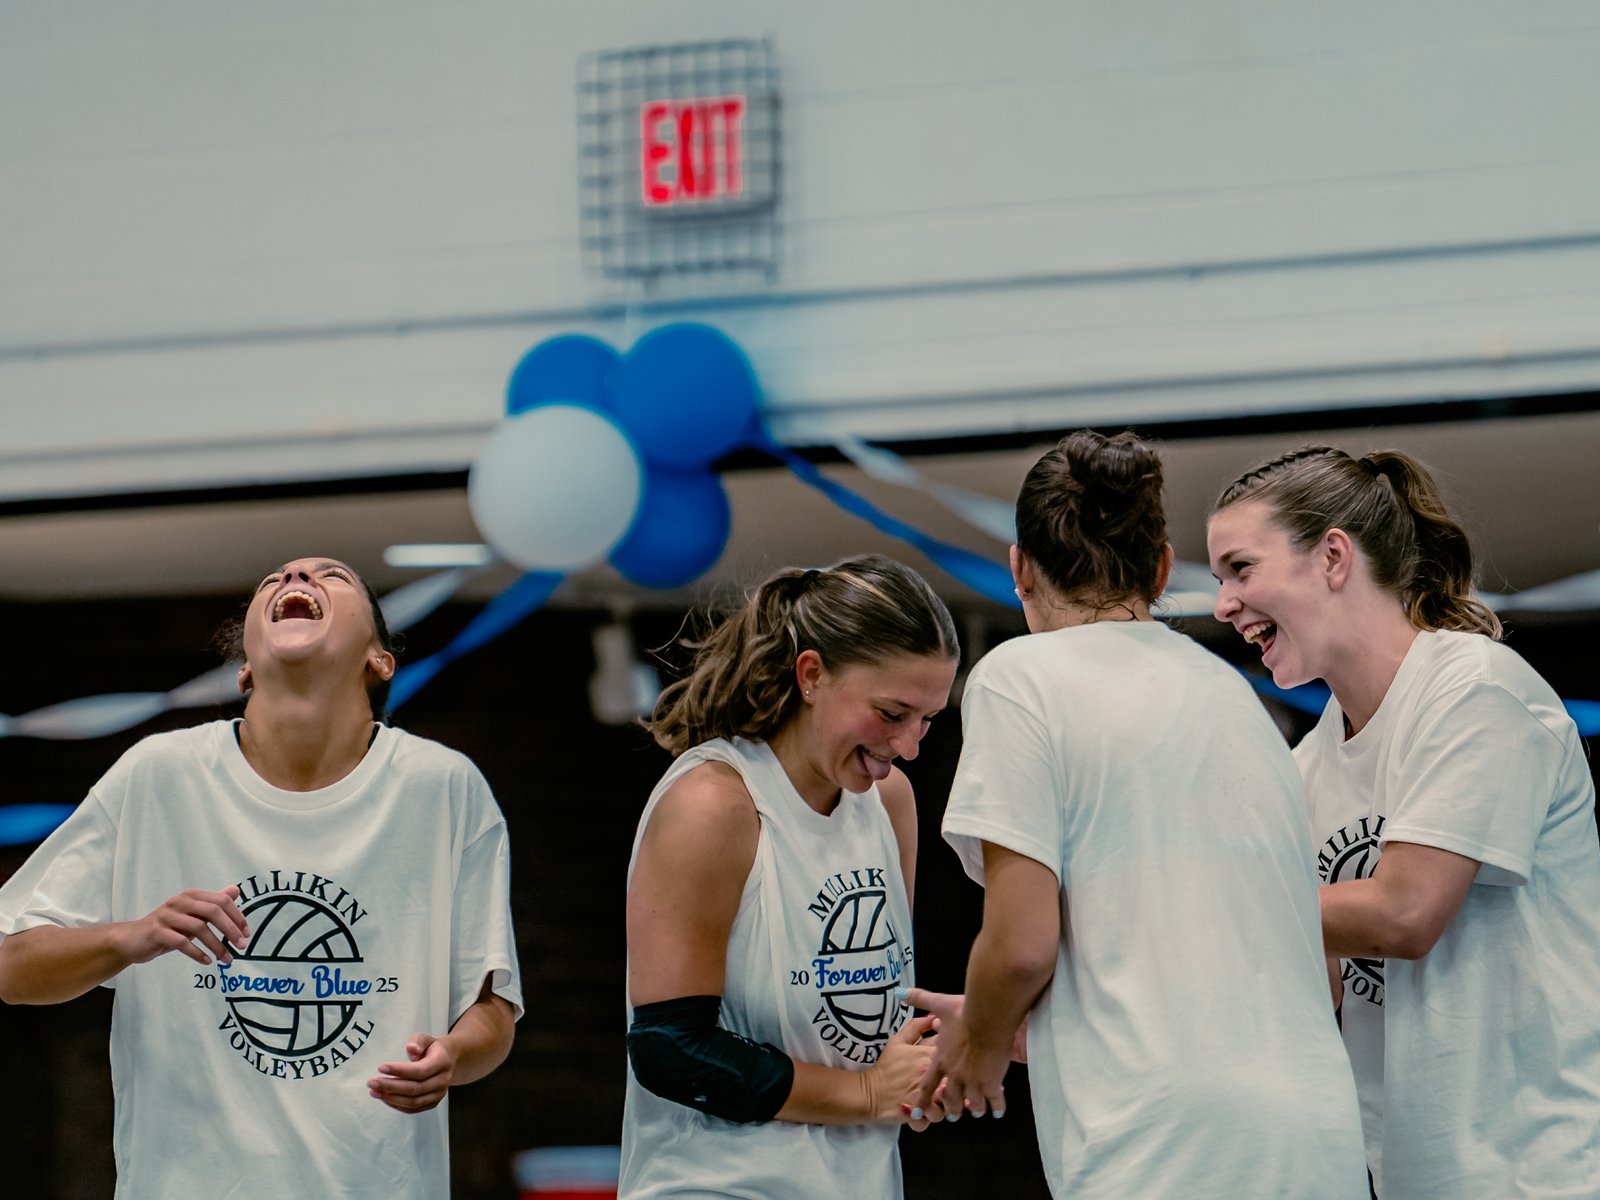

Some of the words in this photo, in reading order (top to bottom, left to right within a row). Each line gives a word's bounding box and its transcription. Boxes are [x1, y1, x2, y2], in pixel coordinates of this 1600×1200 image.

[641, 97, 745, 205] EXIT
[236, 869, 368, 926] ILLIKIN
[808, 868, 886, 922] MILLIK
[193, 974, 216, 989] 20
[217, 963, 305, 995] Forever
[311, 965, 372, 998] Blue
[375, 977, 399, 993] 25
[790, 970, 809, 985] 20
[812, 956, 886, 989] Forever
[218, 1011, 375, 1080] VOLLEYBALL
